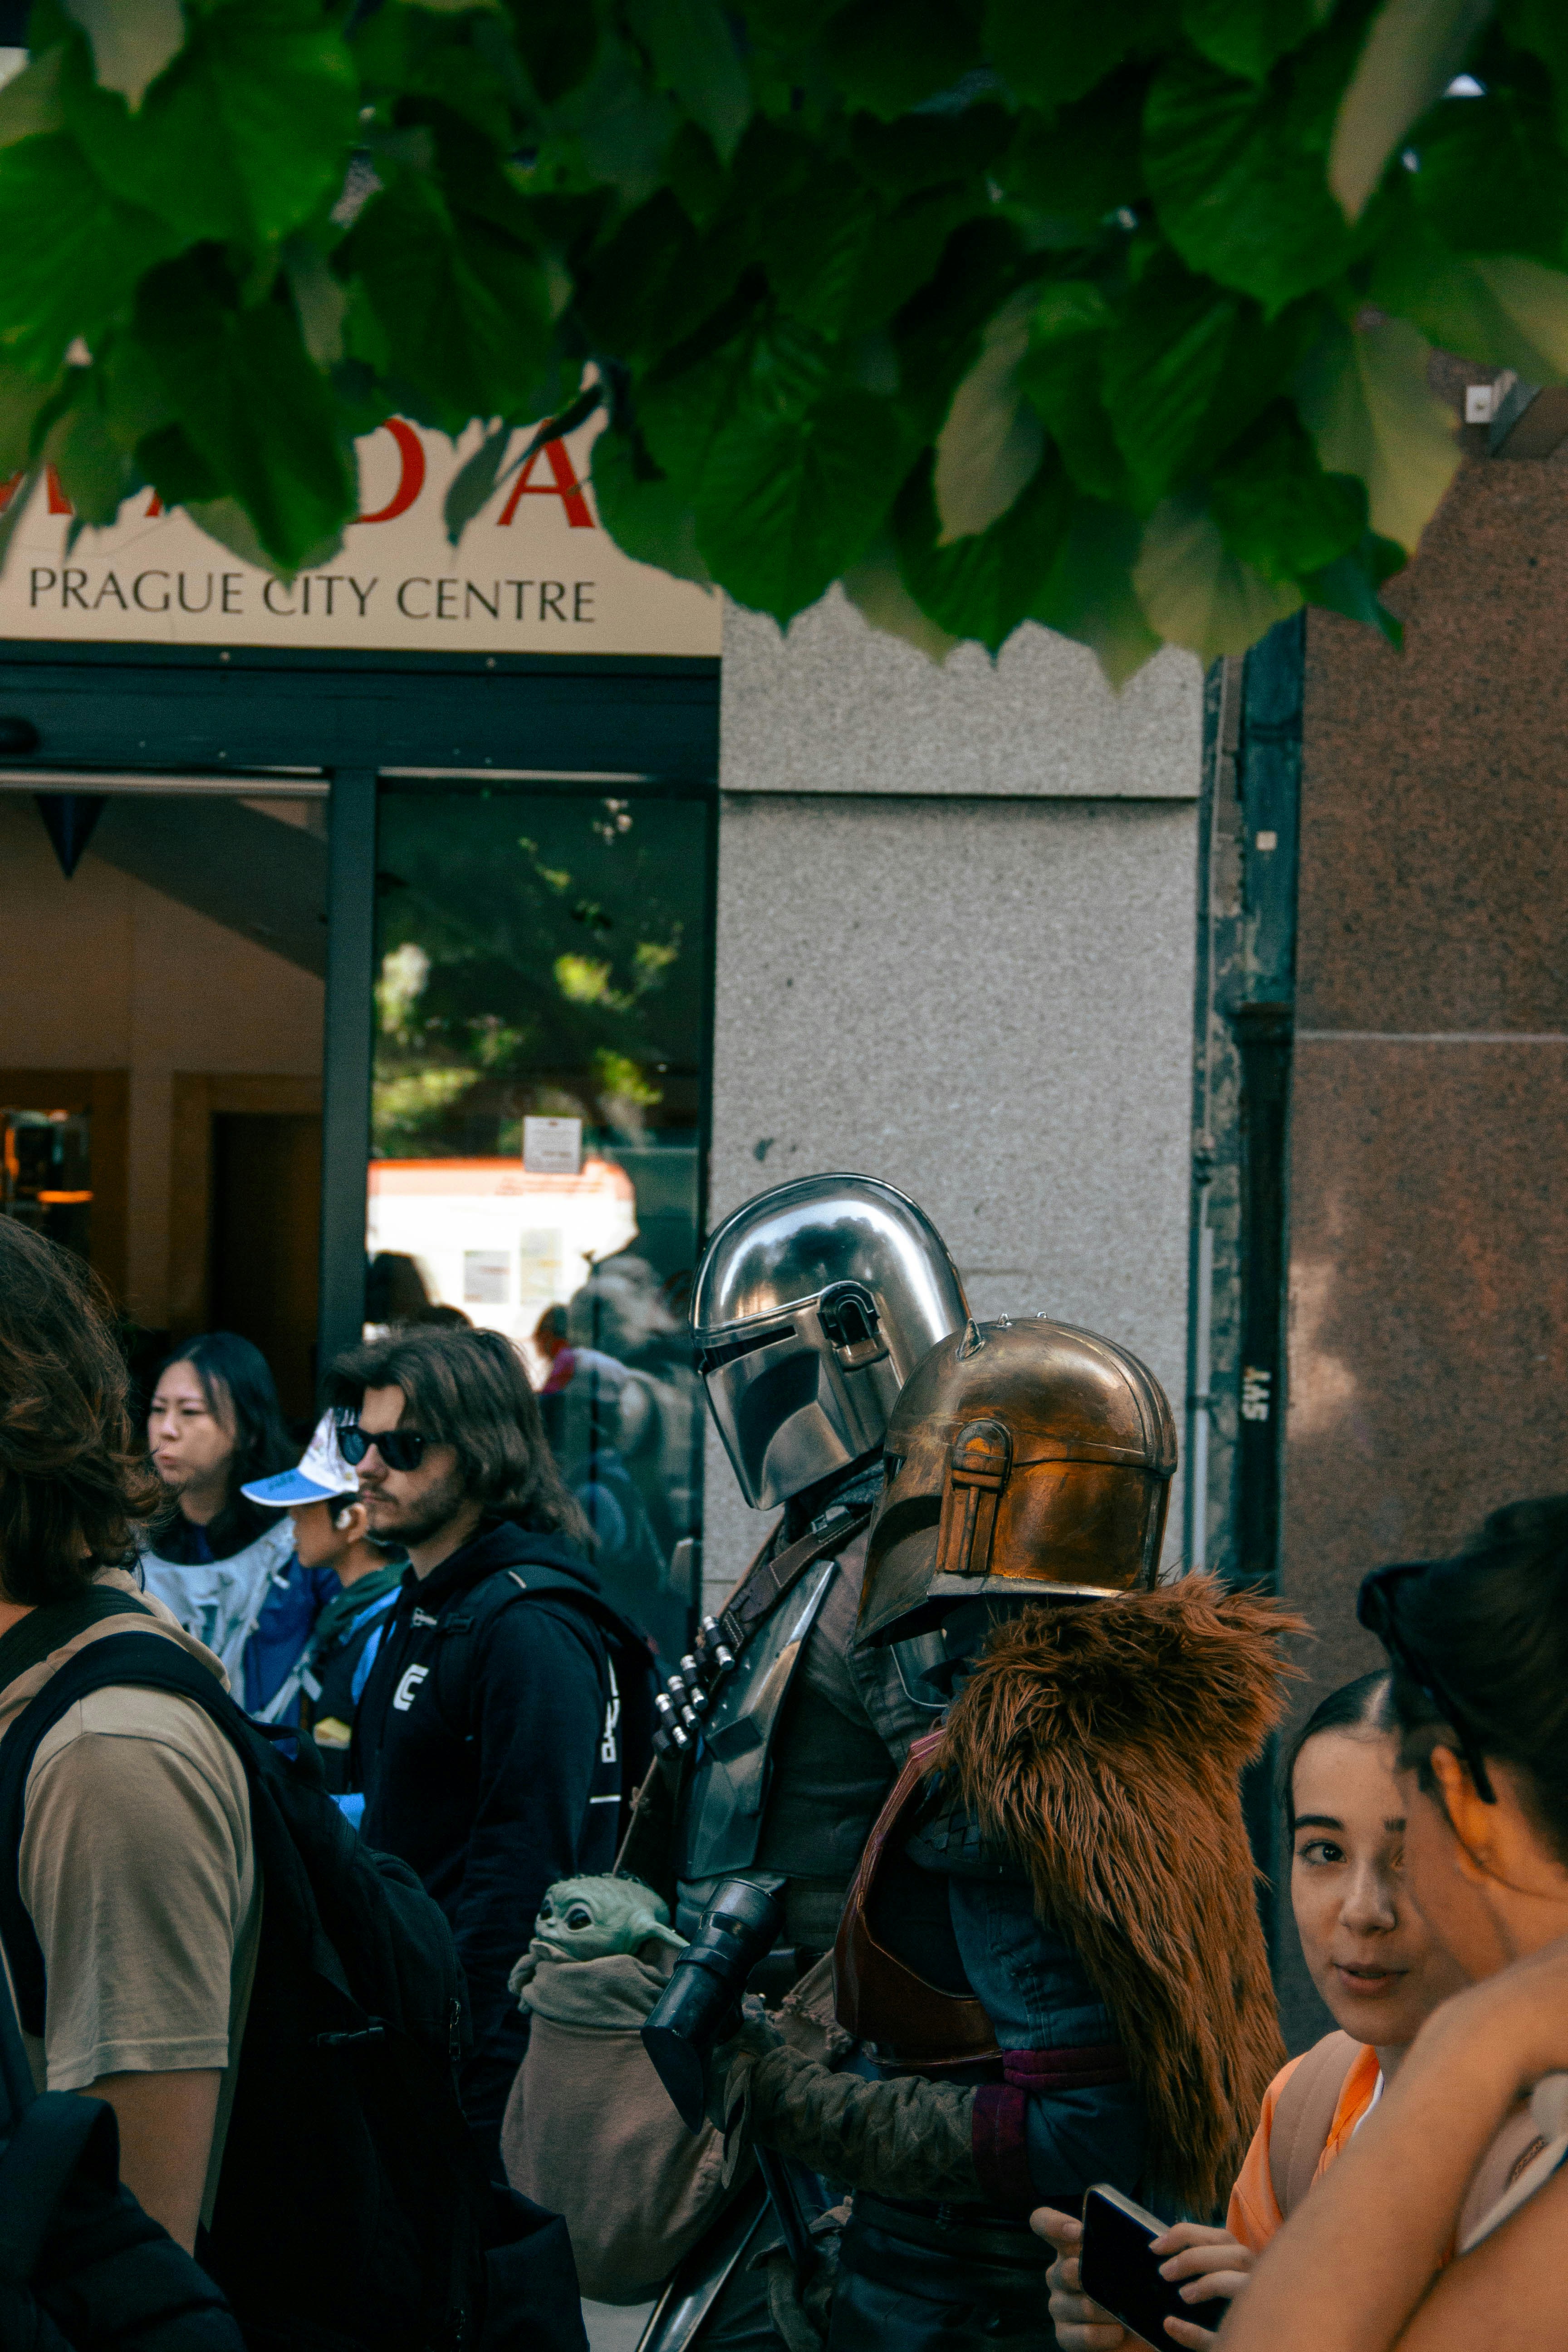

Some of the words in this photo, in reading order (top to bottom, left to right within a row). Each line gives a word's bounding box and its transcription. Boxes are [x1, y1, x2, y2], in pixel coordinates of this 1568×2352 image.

[29, 568, 243, 614] PRAGUE
[263, 575, 378, 617] CITY
[397, 577, 595, 623] CENTRE
